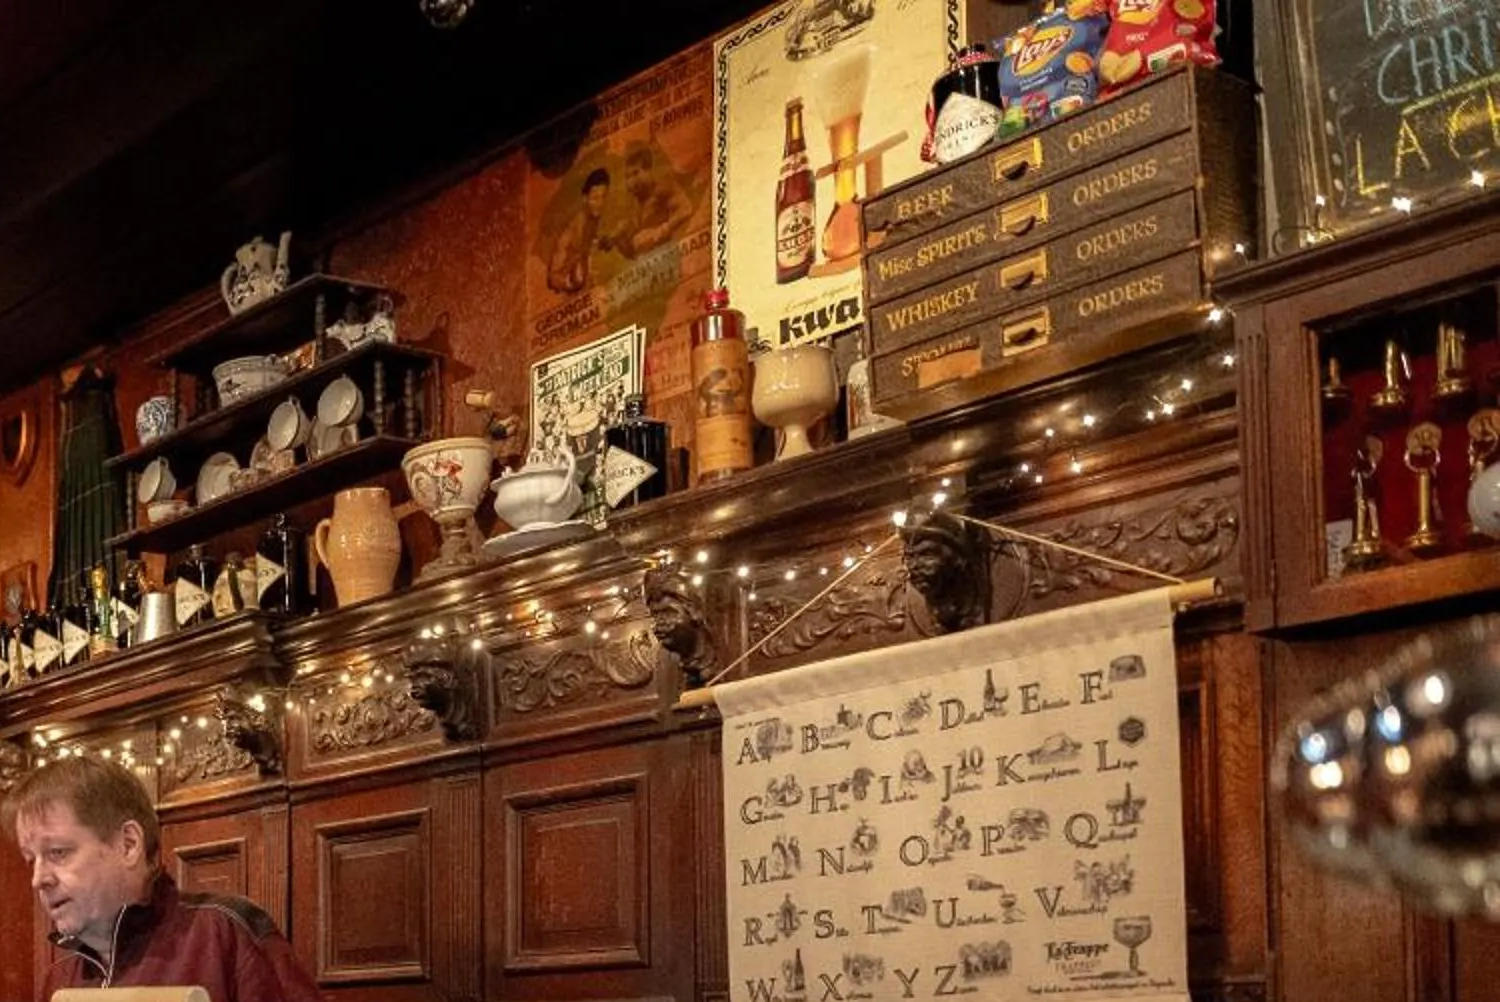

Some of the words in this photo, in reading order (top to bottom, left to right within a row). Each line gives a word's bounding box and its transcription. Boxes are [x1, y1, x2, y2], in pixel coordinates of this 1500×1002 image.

[1377, 17, 1500, 104] CHRI
[1067, 101, 1151, 152] ORDERS
[1073, 159, 1158, 206] ORDERS
[1076, 215, 1158, 261] ORDERS
[886, 281, 980, 332] WHISKEY
[1078, 274, 1164, 317] ORDERS
[779, 297, 861, 345] KWA
[1061, 941, 1110, 961] Trappe
[893, 968, 919, 999] Y
